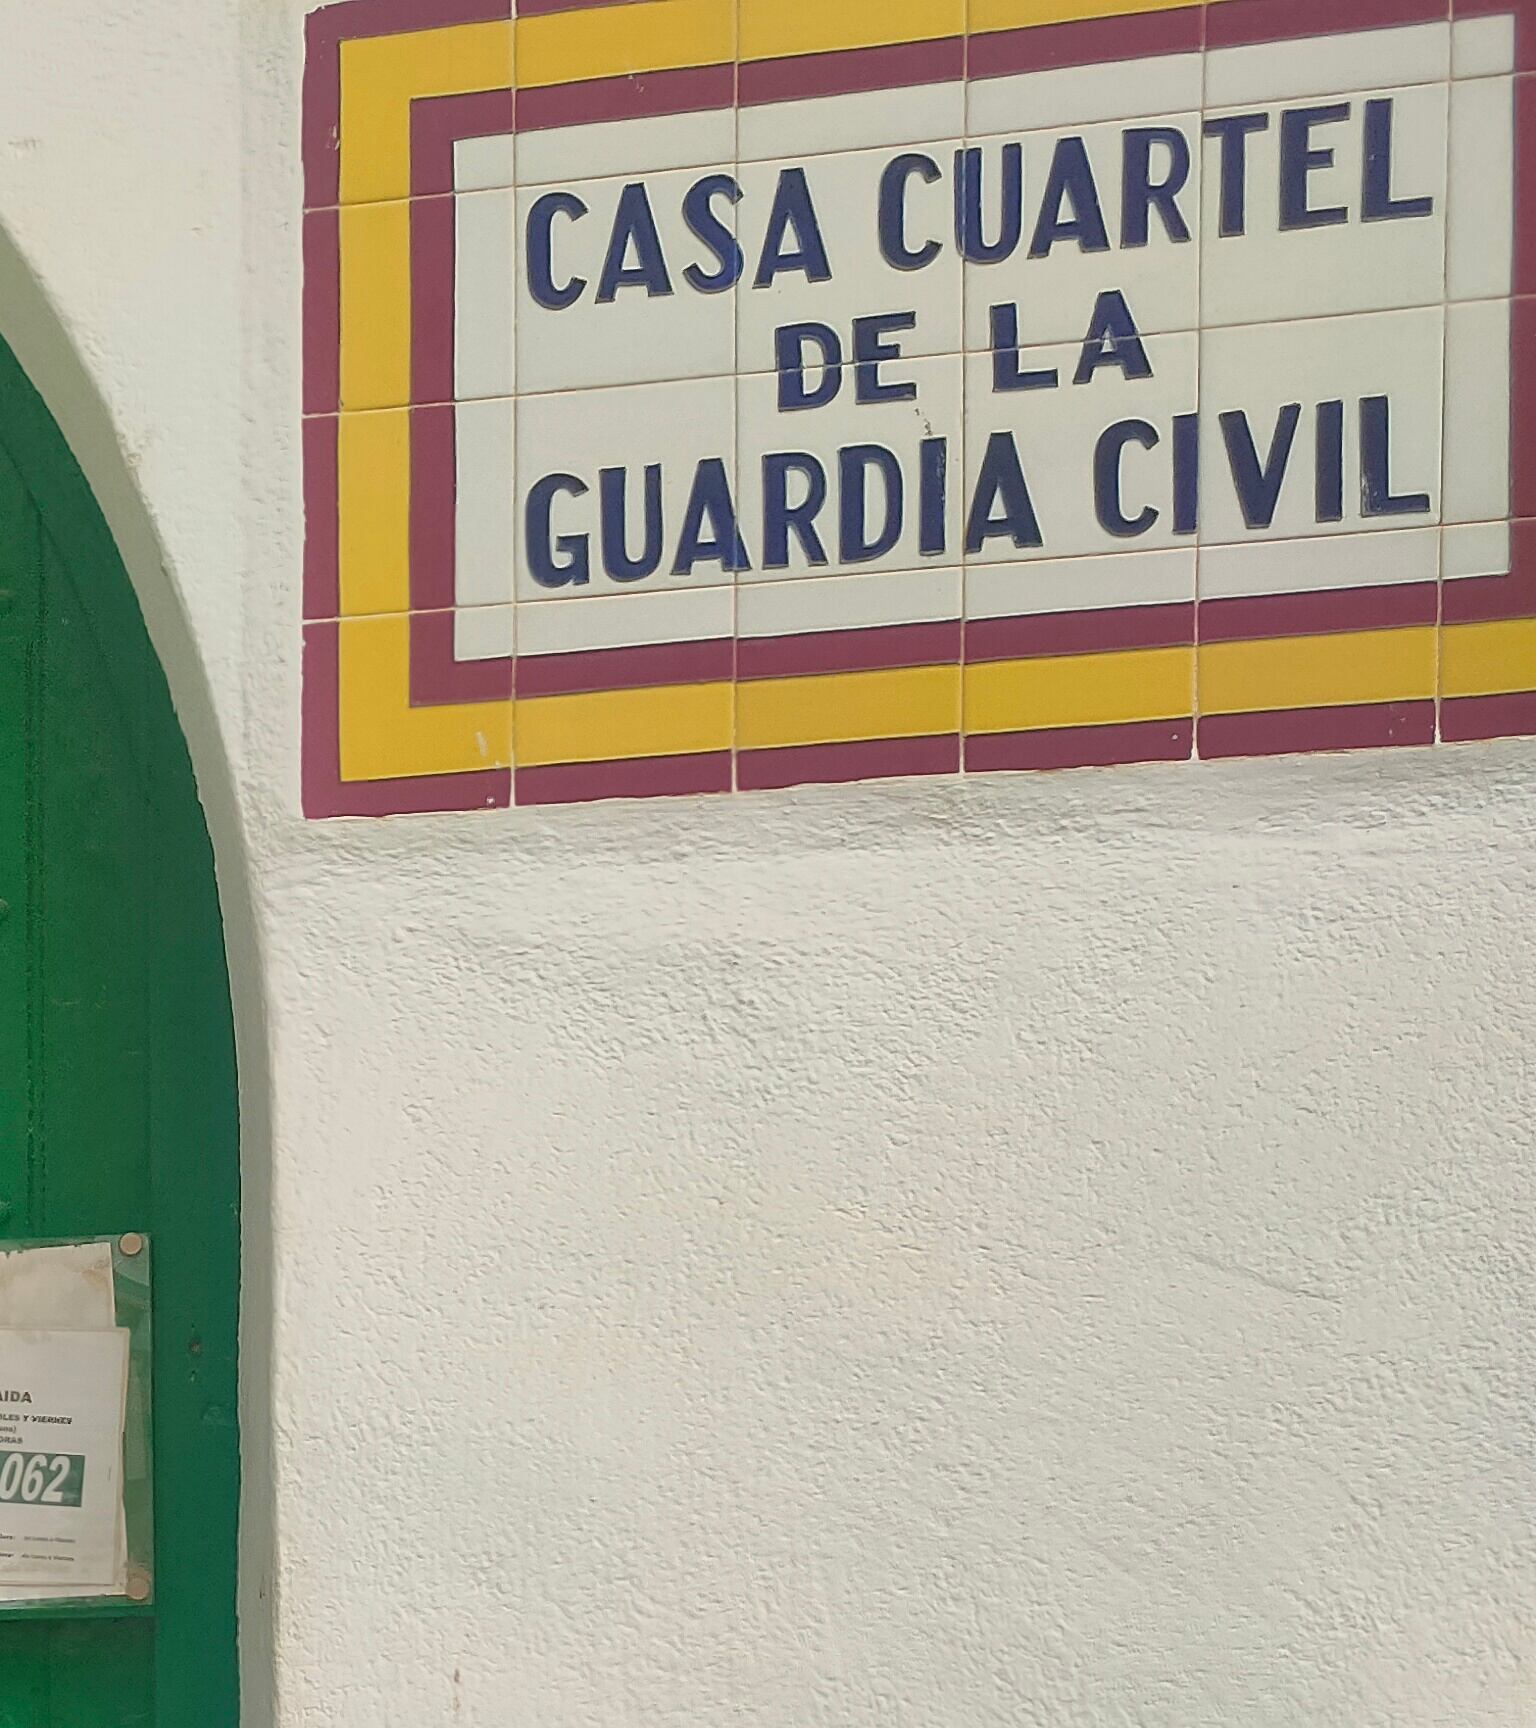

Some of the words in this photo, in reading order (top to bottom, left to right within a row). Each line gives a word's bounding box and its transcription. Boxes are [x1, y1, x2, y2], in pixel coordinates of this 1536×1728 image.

[527, 168, 832, 308] CASA
[879, 99, 1433, 270] CUARTEL
[775, 312, 917, 411] DE
[990, 290, 1152, 391] LA
[526, 431, 1042, 588] GUARDIA
[1094, 396, 1431, 537] CIVIL
